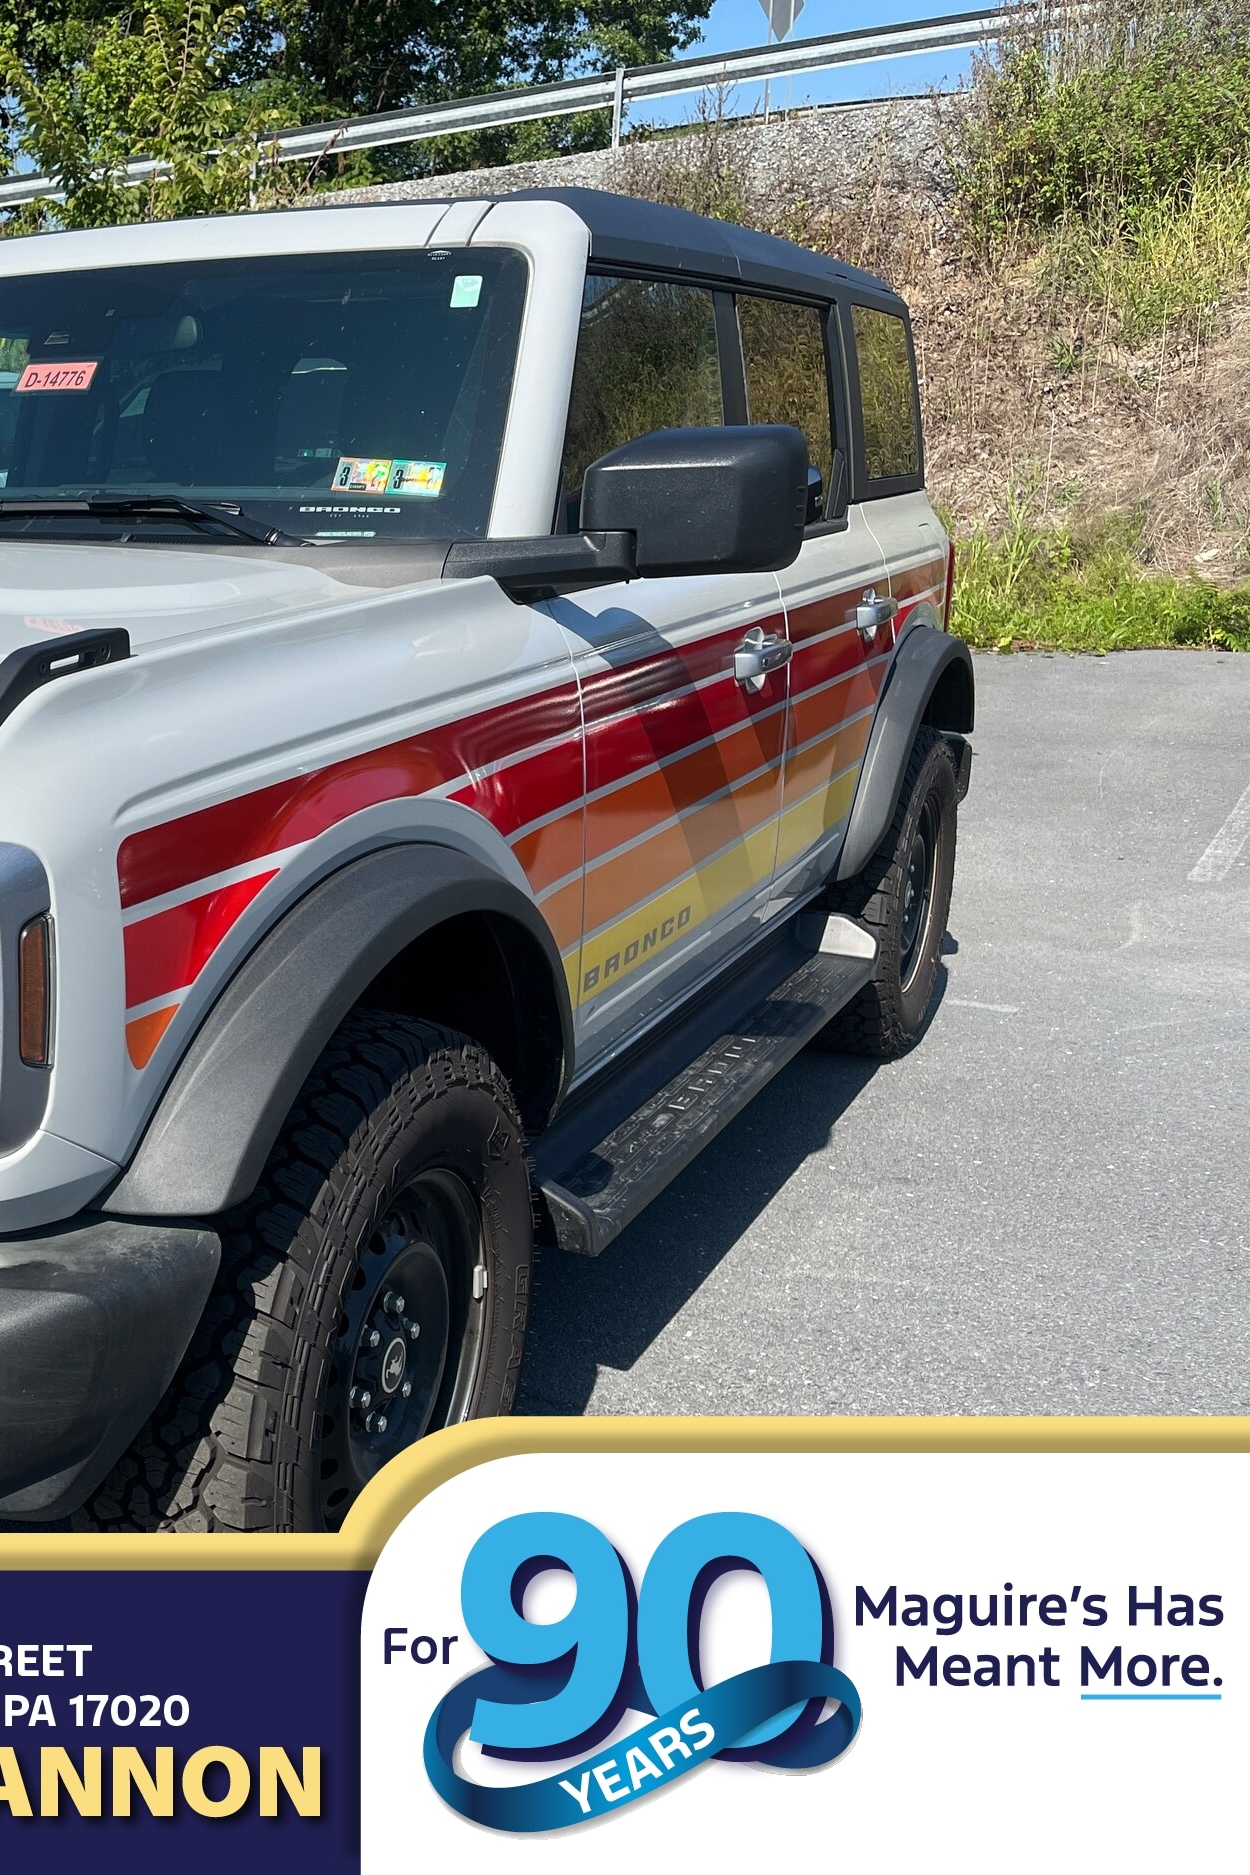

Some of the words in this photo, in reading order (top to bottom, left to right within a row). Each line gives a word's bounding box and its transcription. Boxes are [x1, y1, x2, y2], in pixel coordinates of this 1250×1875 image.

[24, 370, 86, 388] D-14776
[339, 466, 350, 487] 3
[392, 469, 404, 489] 3
[299, 506, 401, 514] BRONCO
[583, 905, 691, 993] BRONCO
